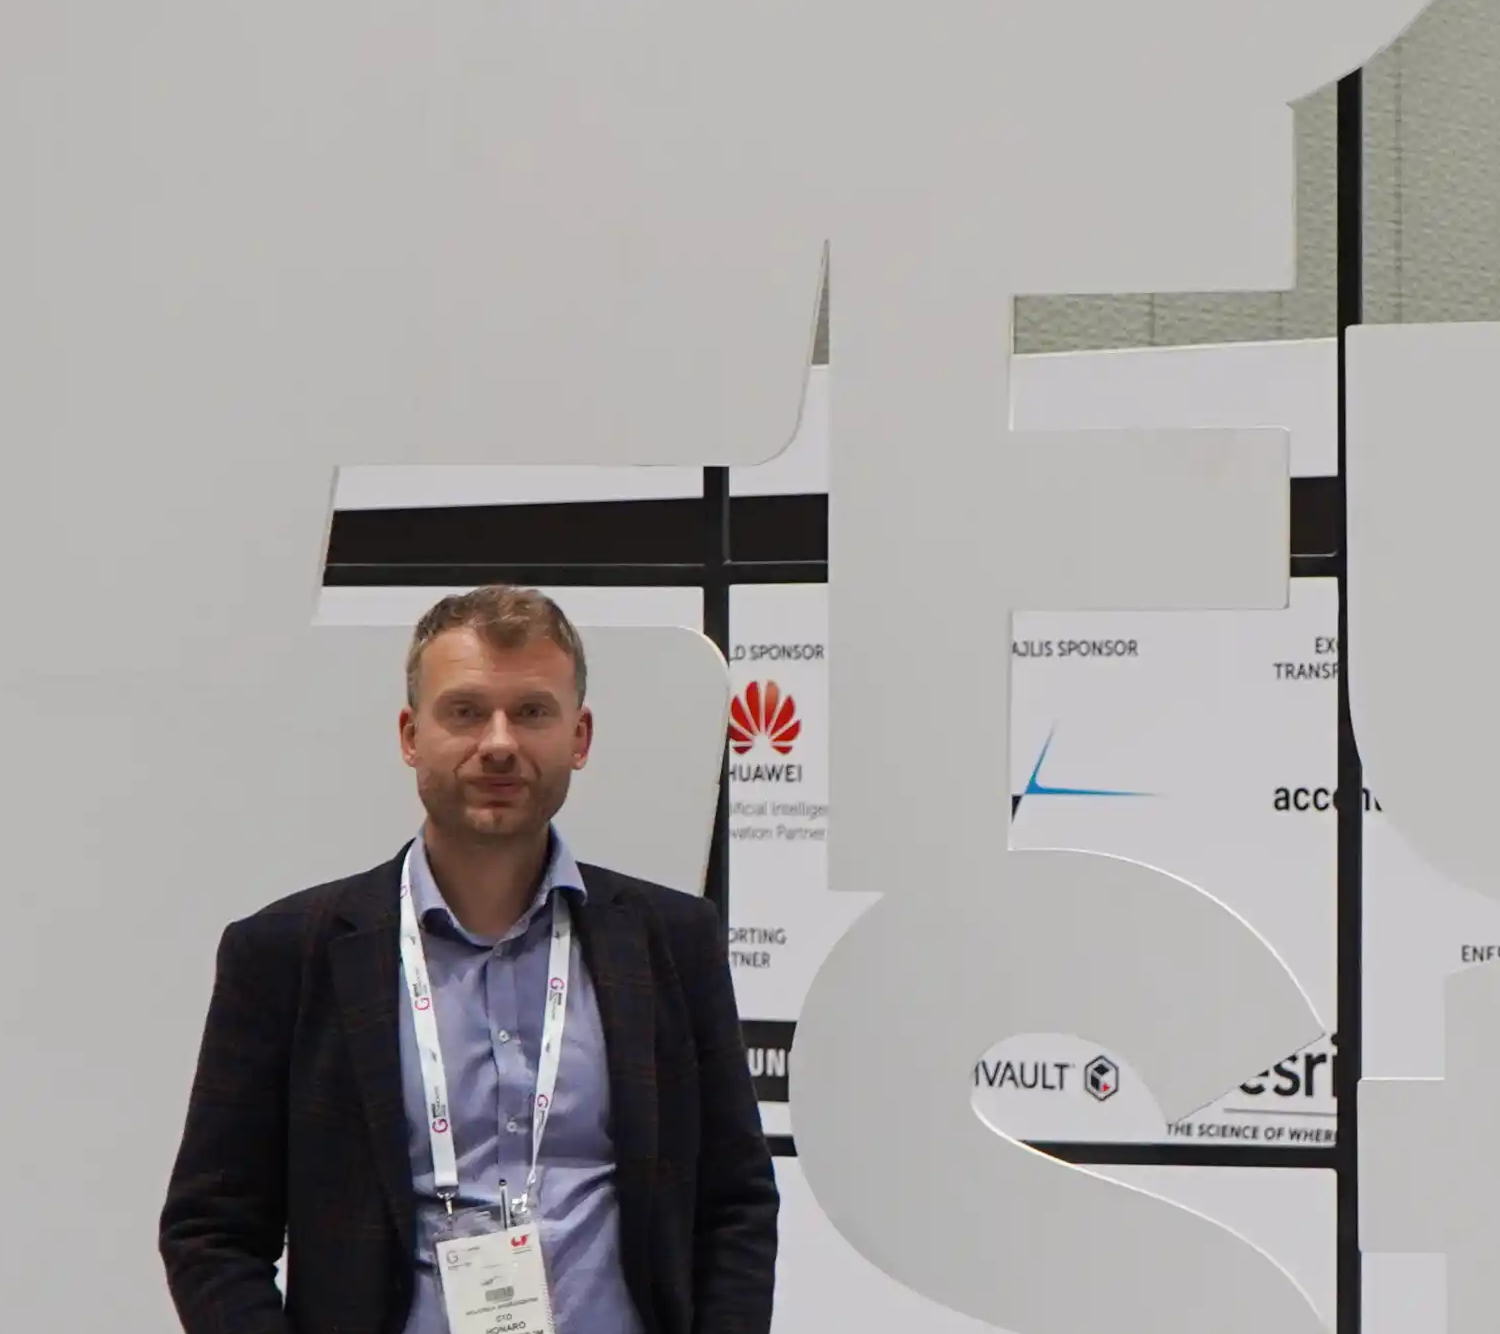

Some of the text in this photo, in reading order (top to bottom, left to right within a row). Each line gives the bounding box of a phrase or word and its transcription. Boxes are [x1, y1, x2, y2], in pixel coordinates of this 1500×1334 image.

[750, 642, 825, 660] SPONSOR
[1057, 639, 1140, 658] SPONSOR
[1167, 1123, 1192, 1138] THE
[1198, 1124, 1257, 1141] SCIENCE
[1264, 1127, 1283, 1142] OF
